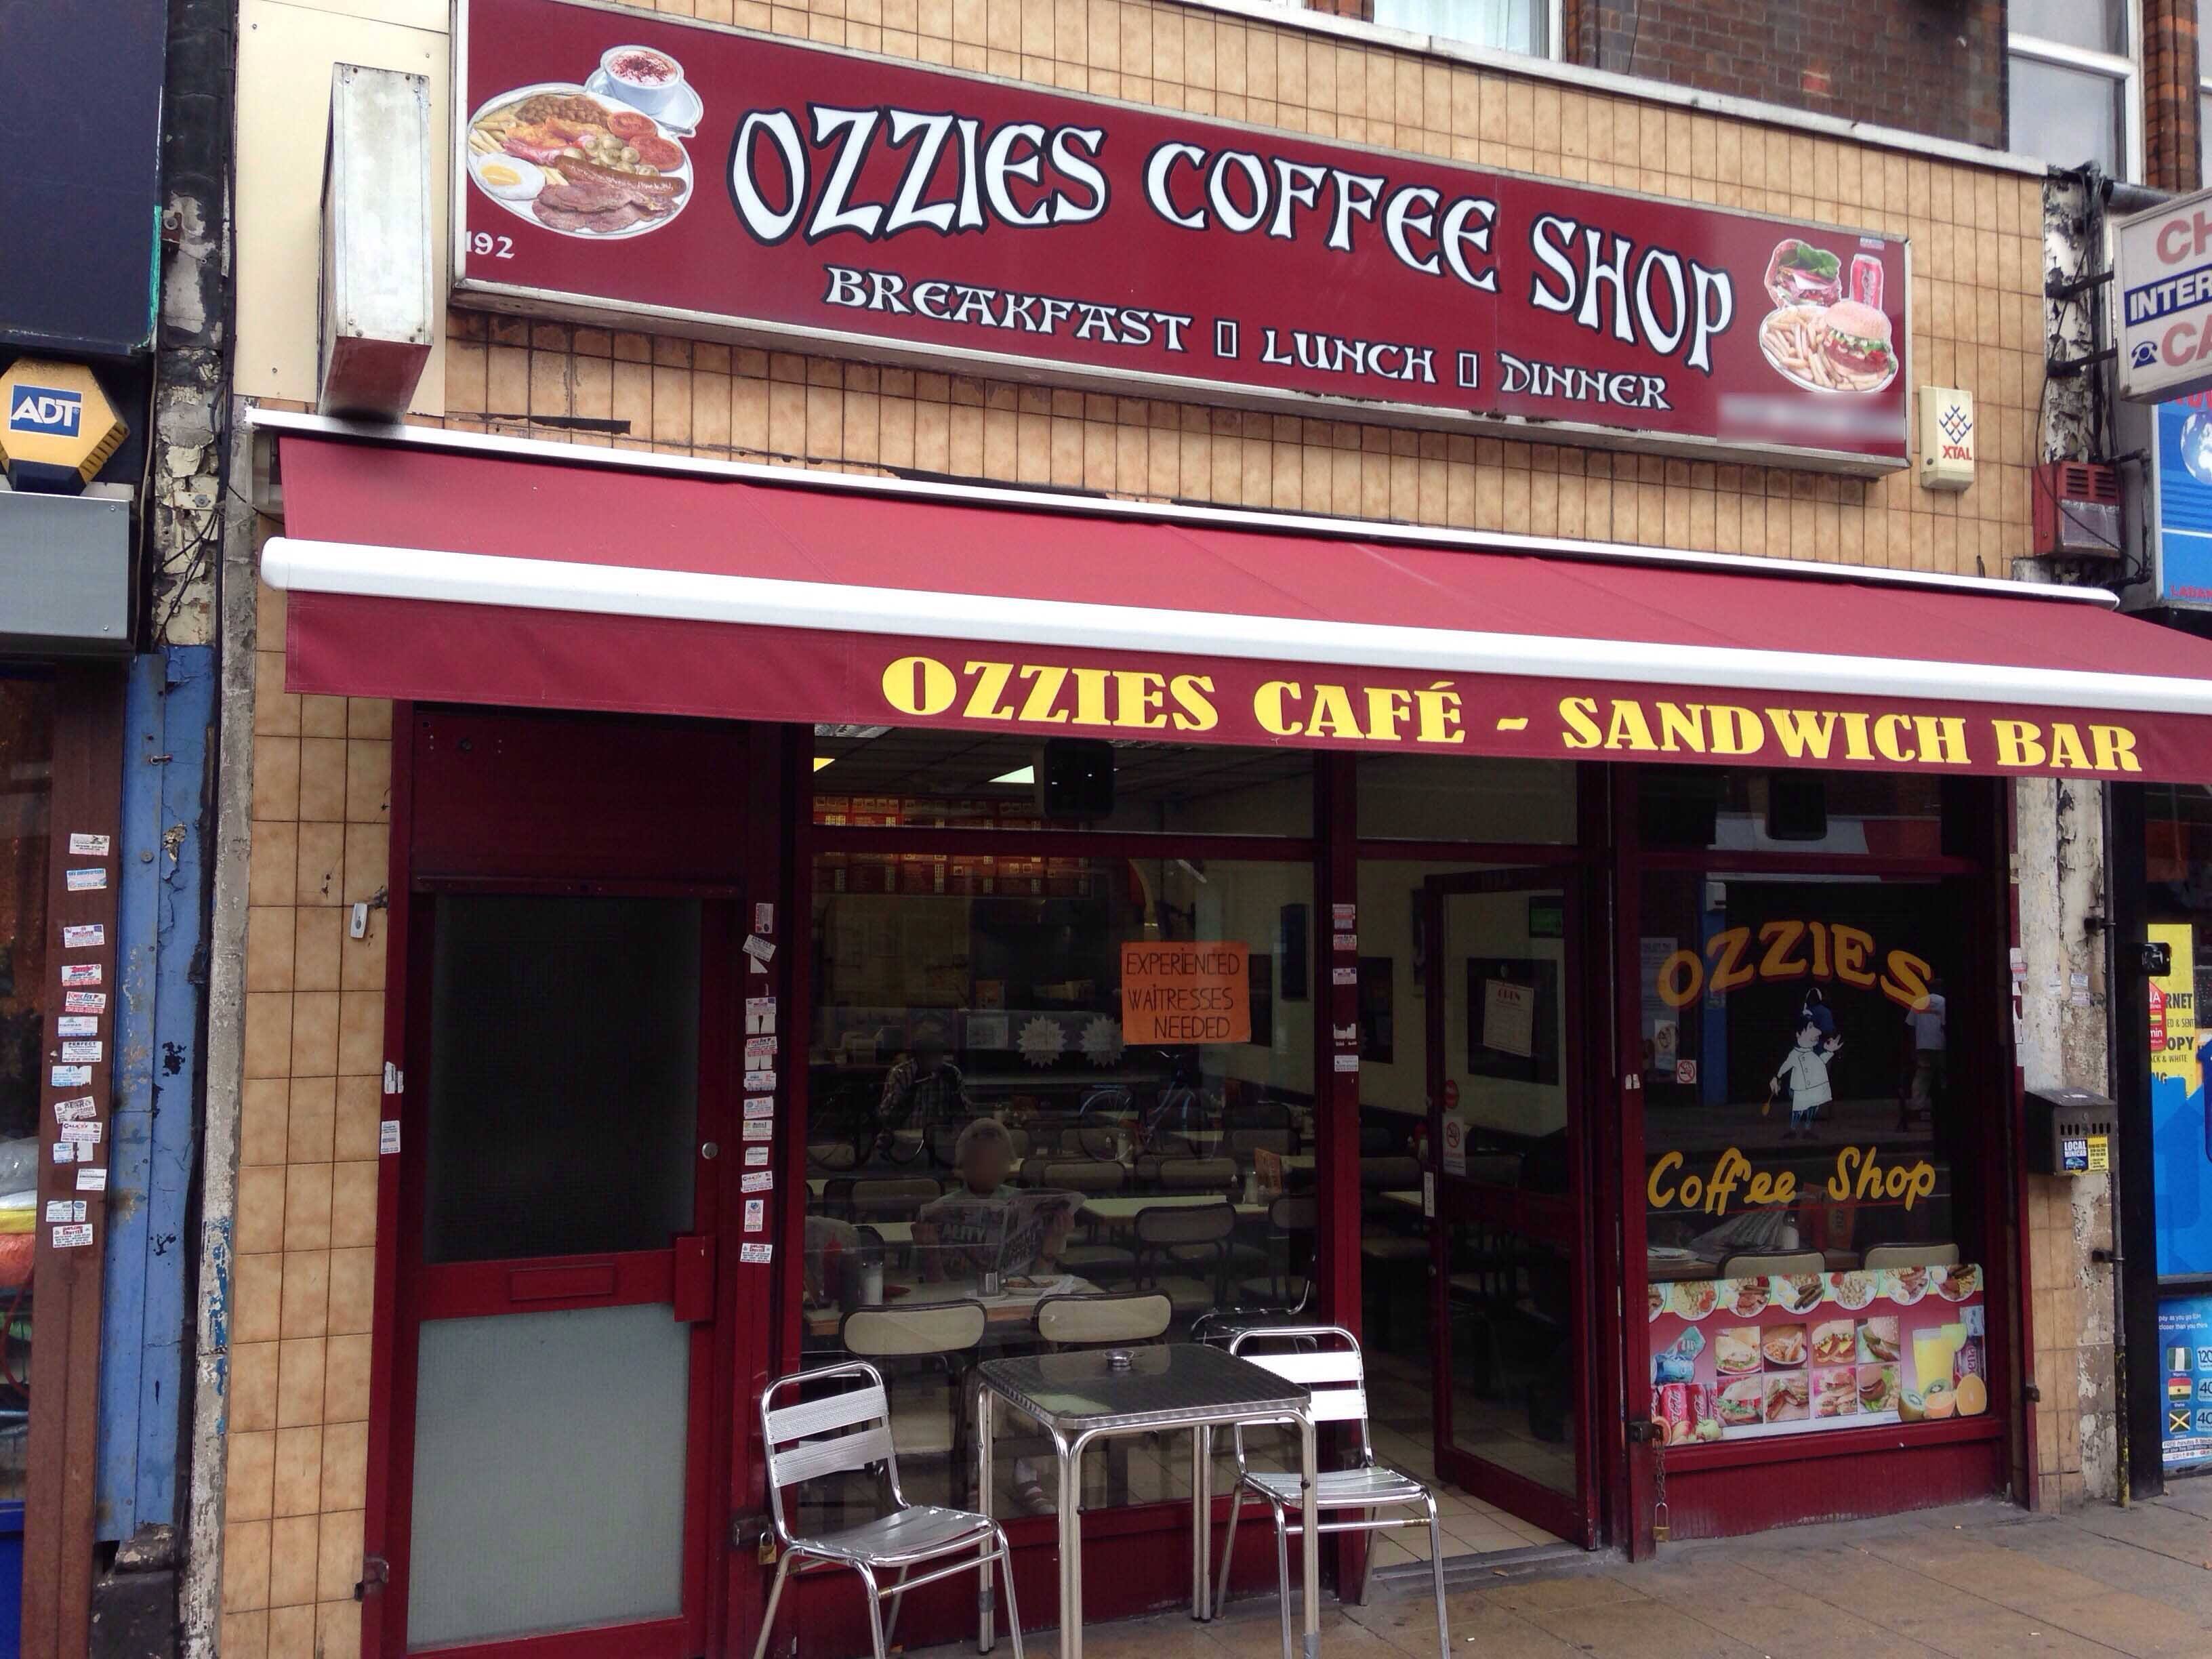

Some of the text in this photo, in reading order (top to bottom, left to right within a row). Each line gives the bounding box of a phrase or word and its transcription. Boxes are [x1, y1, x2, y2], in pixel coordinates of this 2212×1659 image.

[466, 230, 516, 259] 192
[732, 106, 1734, 372] OZZIES COFFEE SHOP
[2129, 269, 2212, 323] INTER
[825, 266, 1673, 411] BREAKFAST LUNCH DINNER
[11, 395, 81, 428] ADT
[1942, 444, 1973, 462] XTAL
[881, 655, 1219, 731] OZZIES
[1254, 680, 1466, 743] CAFÉ
[1558, 697, 1971, 765] SANDWICH
[1992, 720, 2142, 772] BAR
[1126, 947, 1240, 976] EXPERIENCED
[1657, 920, 1934, 1013] OZZIES
[1127, 983, 1234, 1011] WAITRESSES
[1154, 1016, 1231, 1039] NEEDED
[2169, 1054, 2187, 1063] WHITE
[2064, 1140, 2087, 1151] LOCAL
[1647, 1145, 1937, 1216] Coffee Shop
